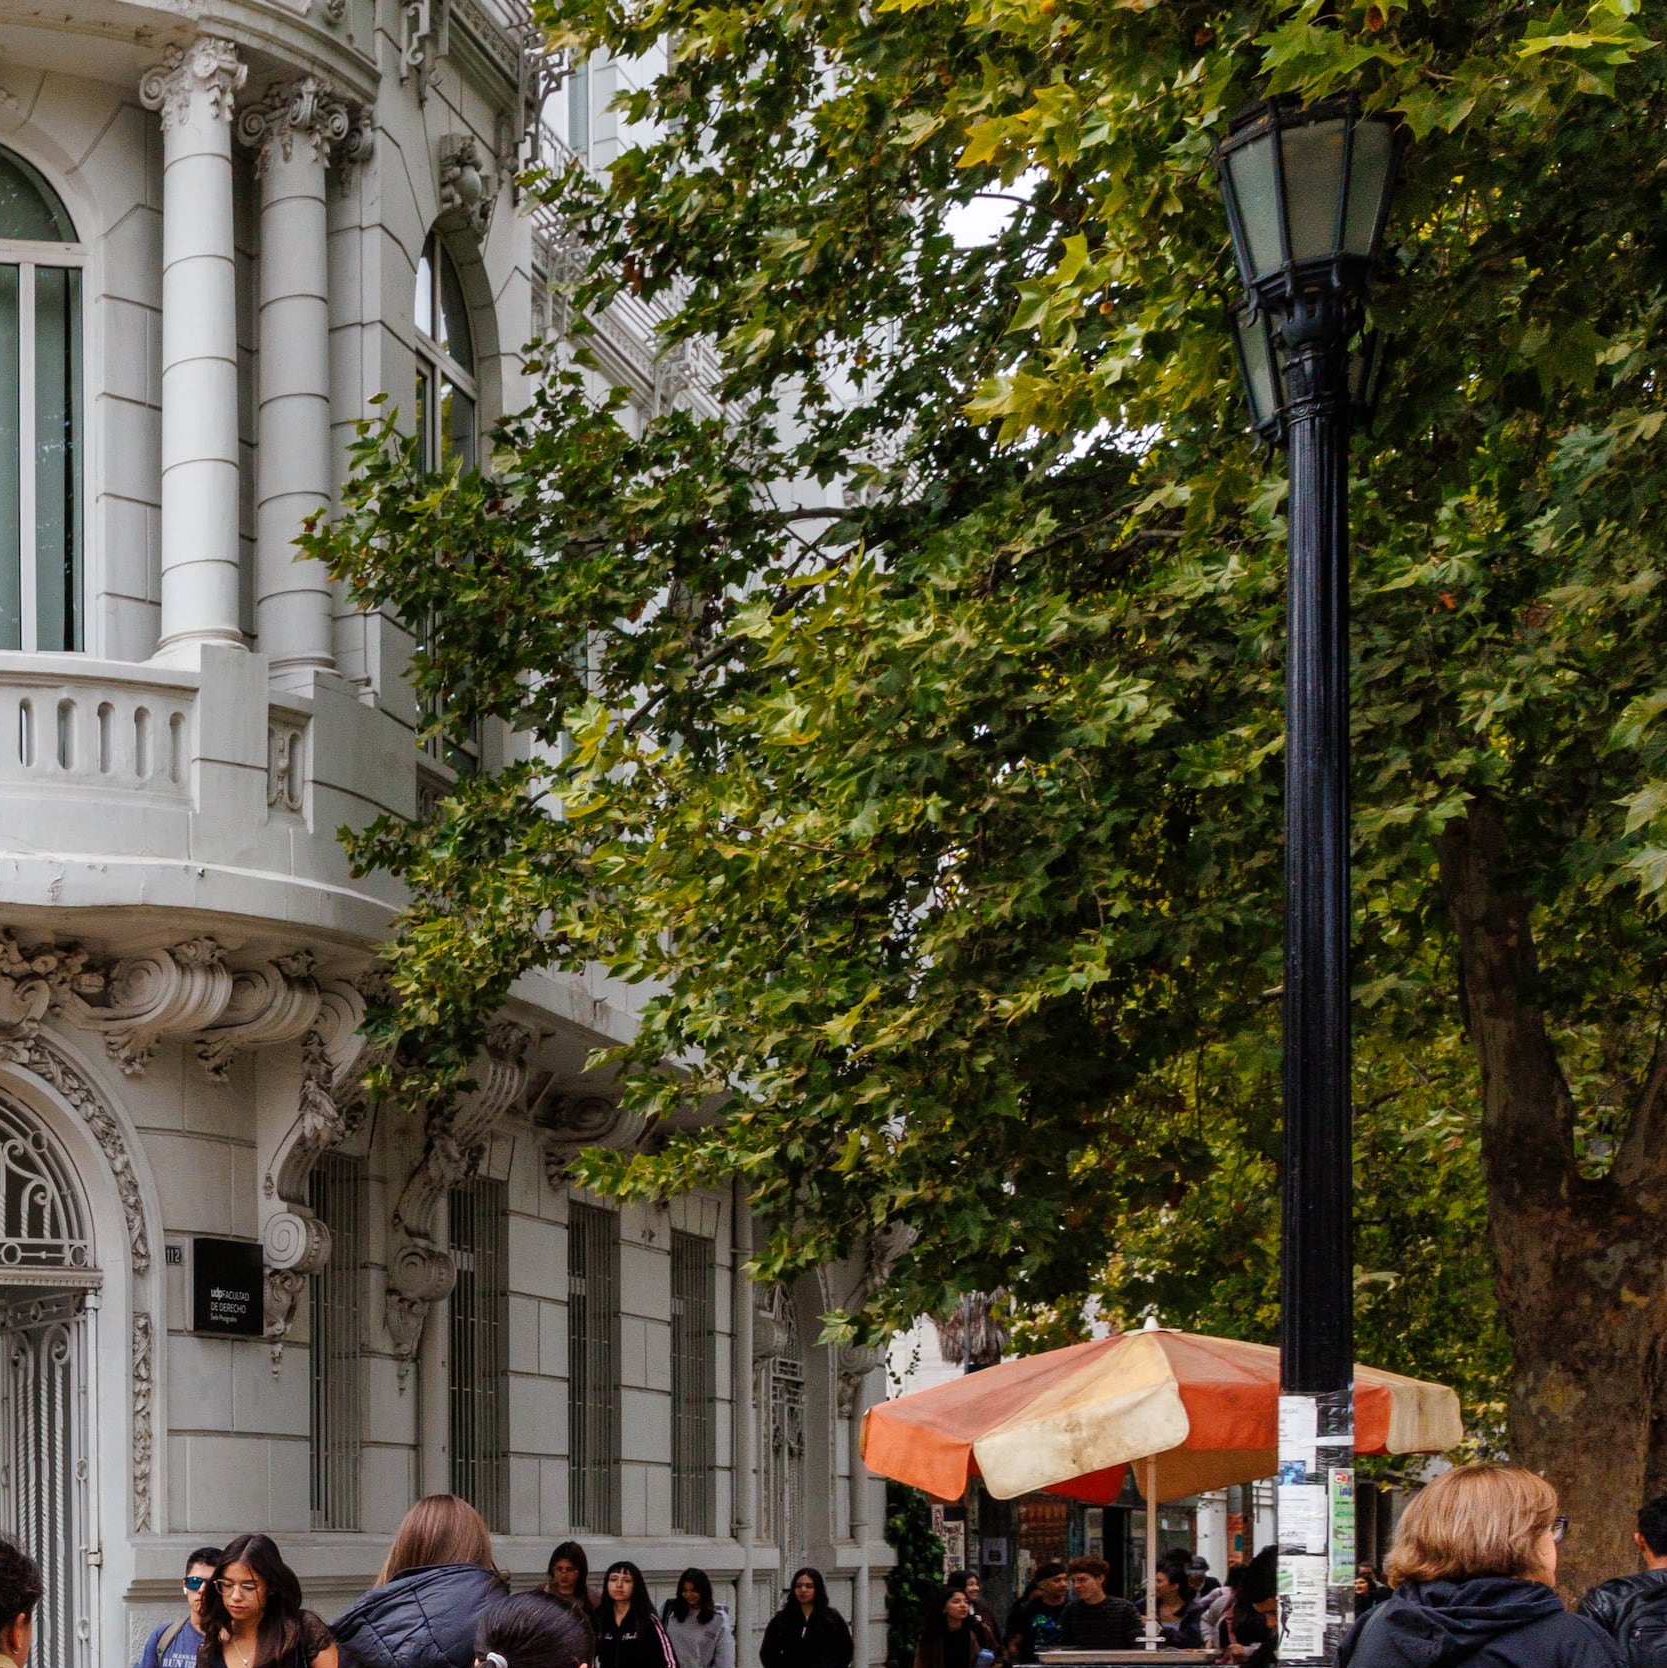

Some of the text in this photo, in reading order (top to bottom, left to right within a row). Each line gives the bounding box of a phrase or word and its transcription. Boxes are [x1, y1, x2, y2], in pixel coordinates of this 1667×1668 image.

[166, 1248, 181, 1263] 112
[210, 1301, 247, 1314] DE DERECHO
